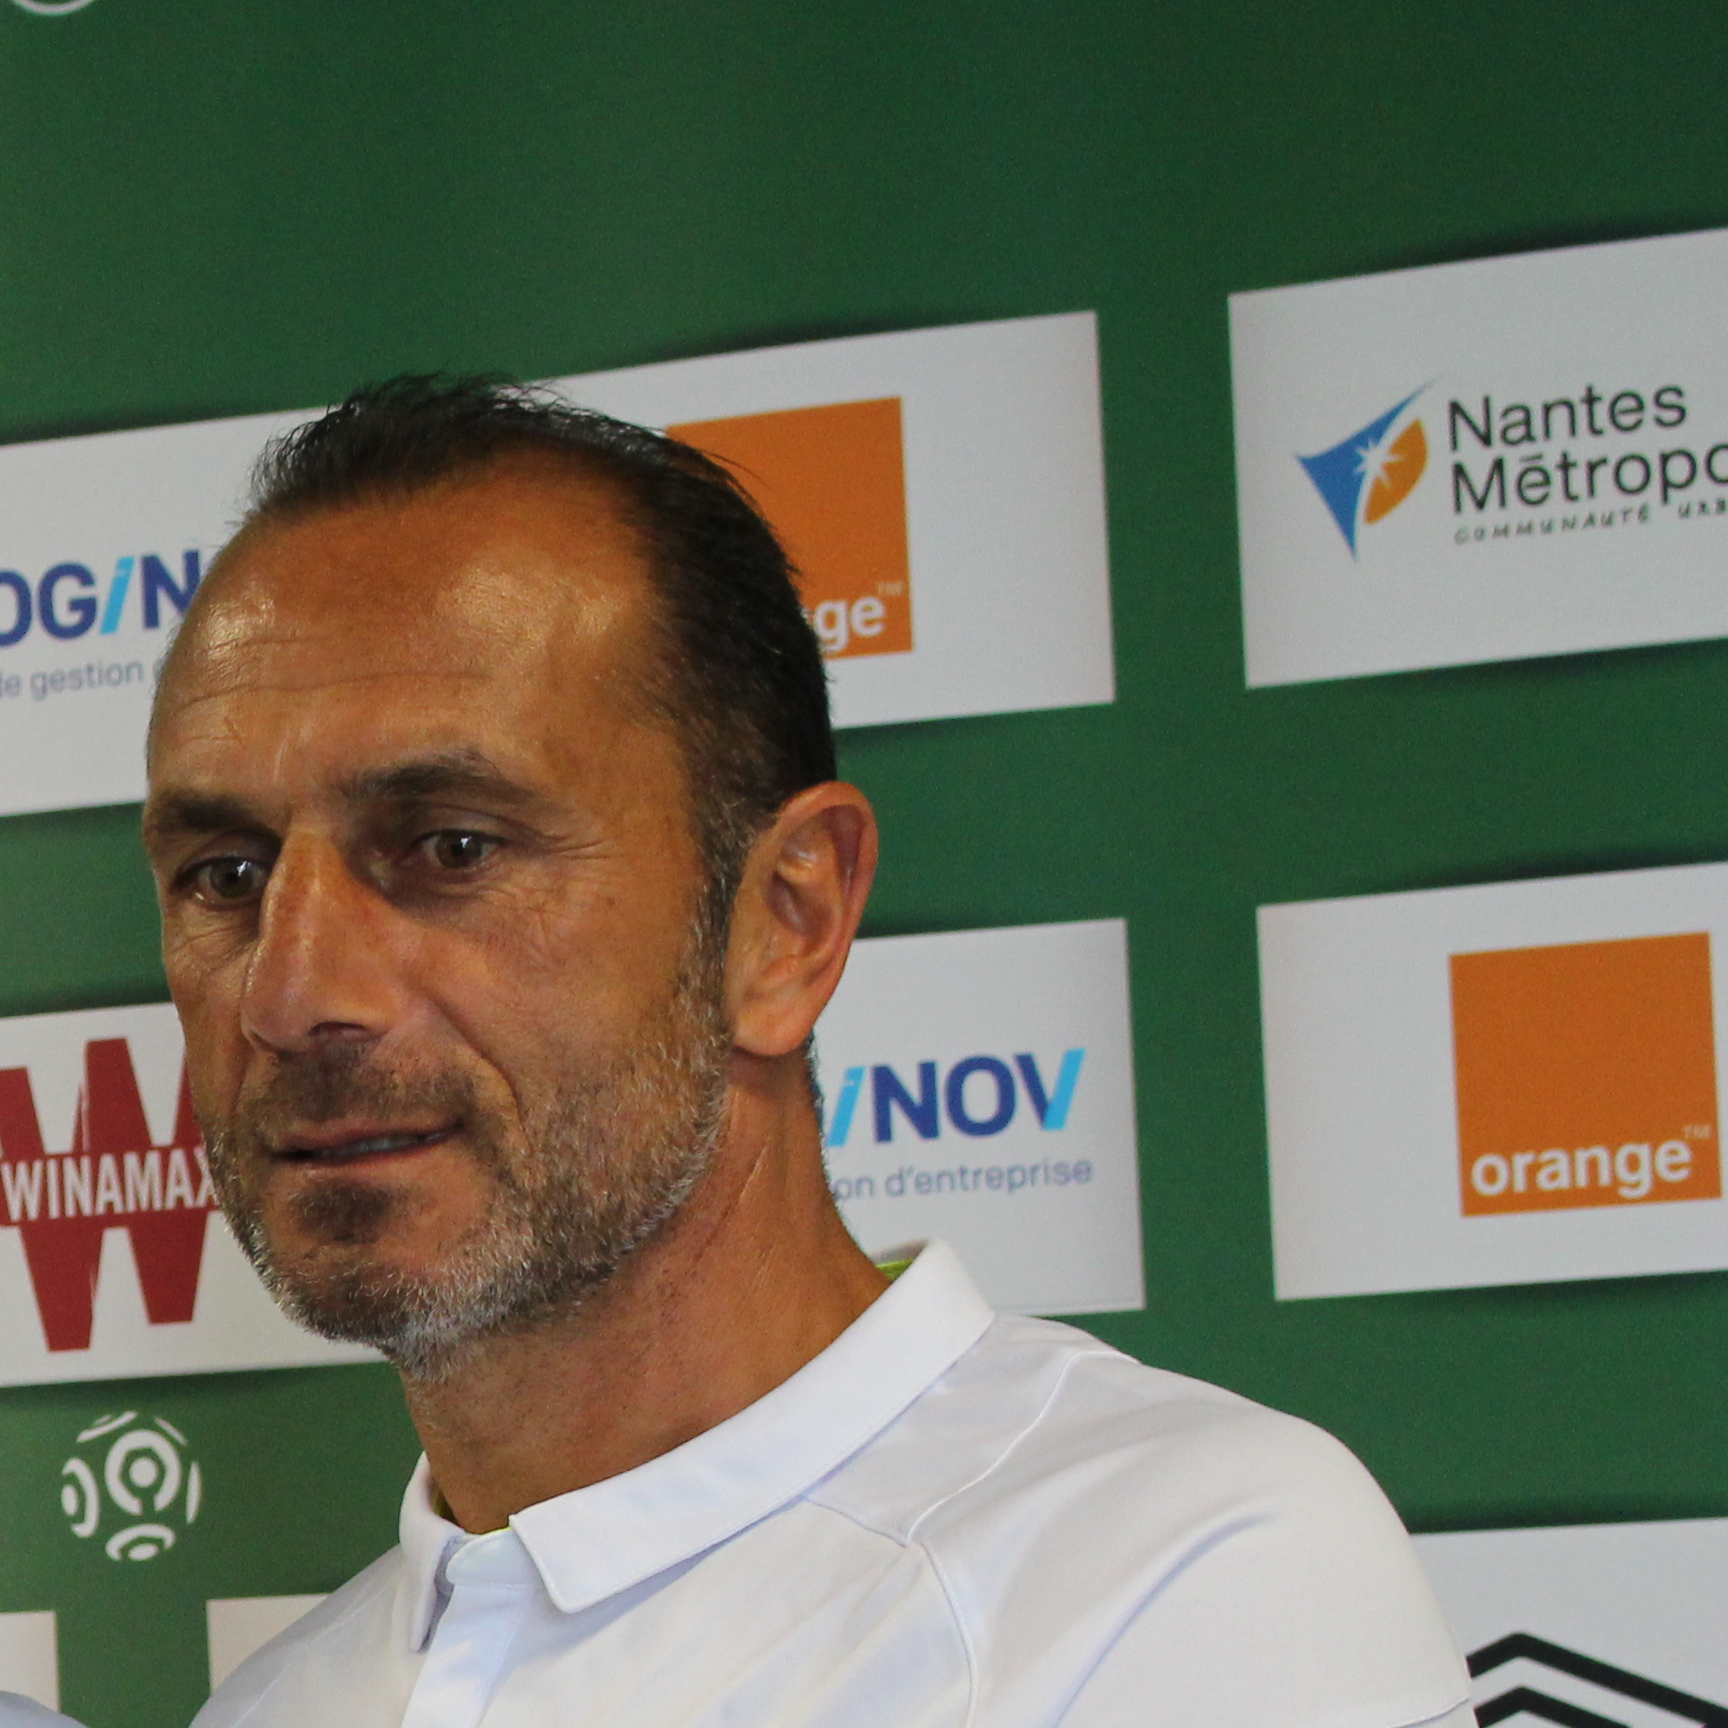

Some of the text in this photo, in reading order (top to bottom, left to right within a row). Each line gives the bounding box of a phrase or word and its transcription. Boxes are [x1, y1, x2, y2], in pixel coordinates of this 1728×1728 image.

[1448, 383, 1687, 452] Nantes
[30, 659, 144, 702] gestion
[885, 1157, 1094, 1198] d'entreprise
[1471, 1139, 1691, 1199] orange
